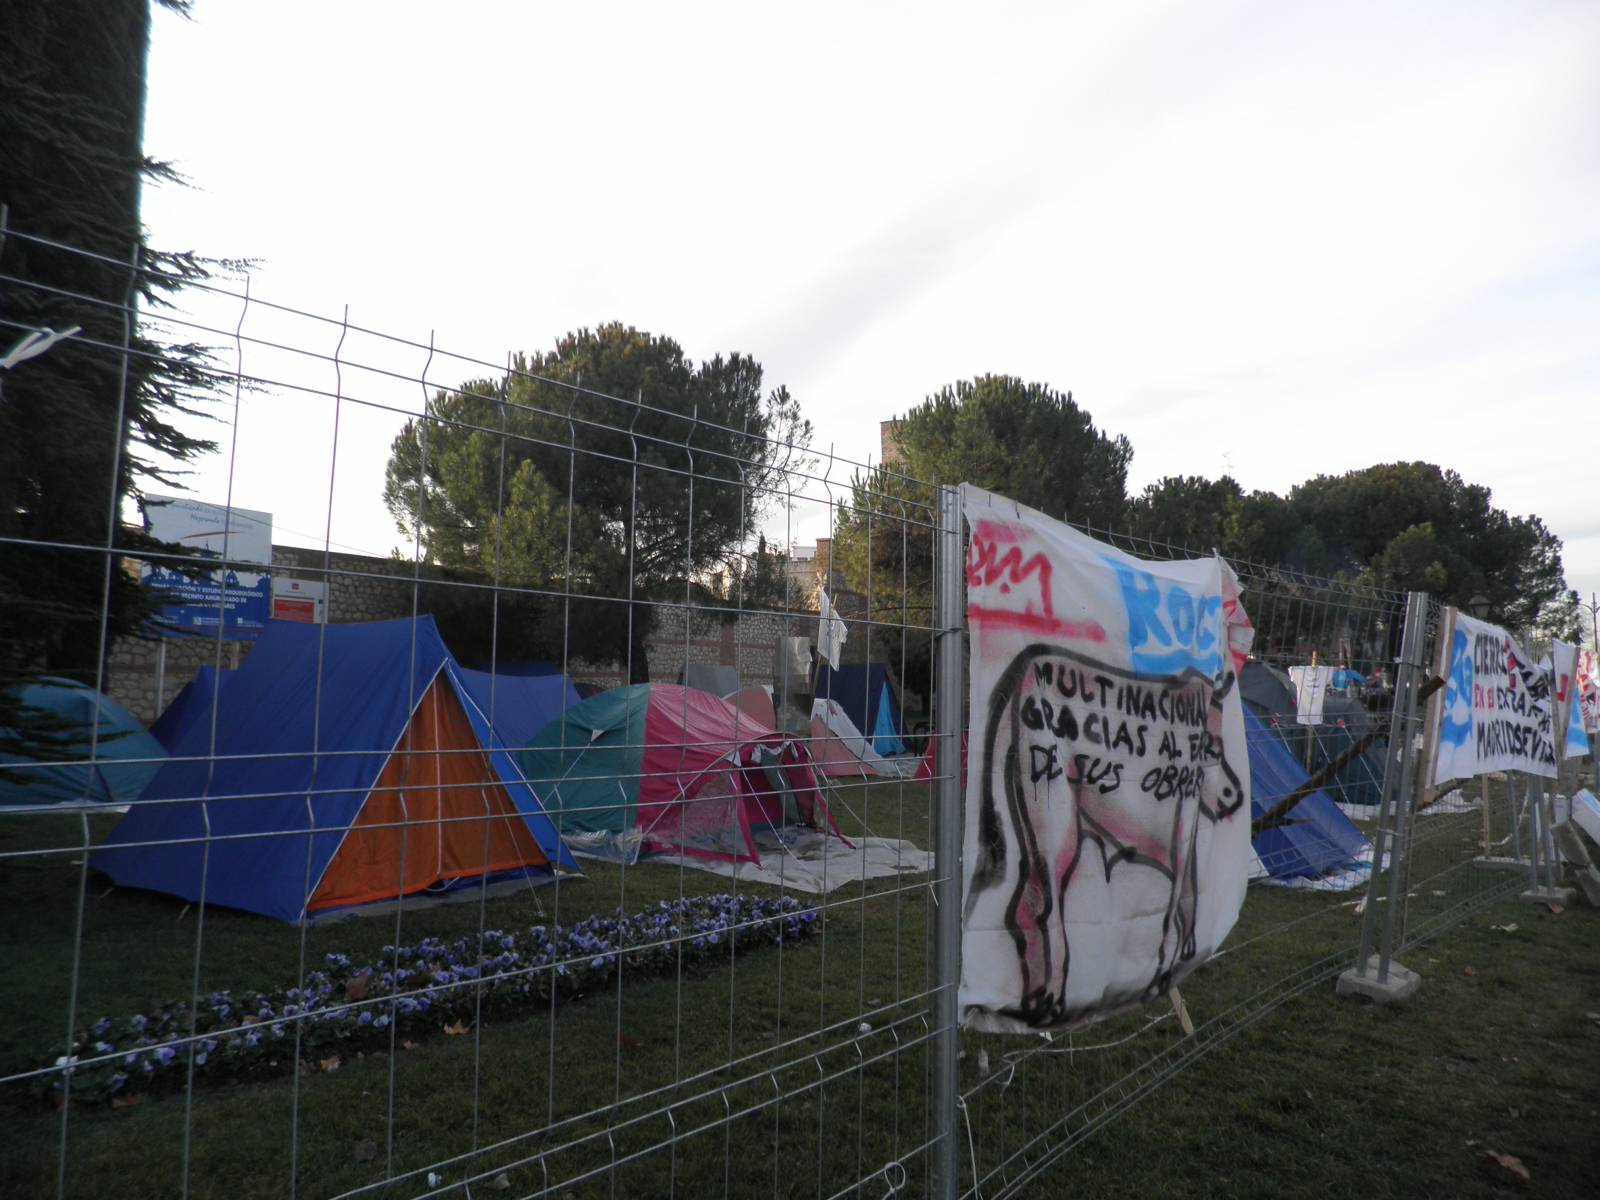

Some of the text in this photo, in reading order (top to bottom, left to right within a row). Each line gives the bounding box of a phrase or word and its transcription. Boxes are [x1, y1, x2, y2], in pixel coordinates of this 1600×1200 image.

[205, 595, 240, 603] AMURLLADO
[1021, 694, 1148, 757] GRACIAS
[1159, 730, 1183, 760] AL
[1030, 743, 1062, 783] DE
[1067, 753, 1124, 794] SUS
